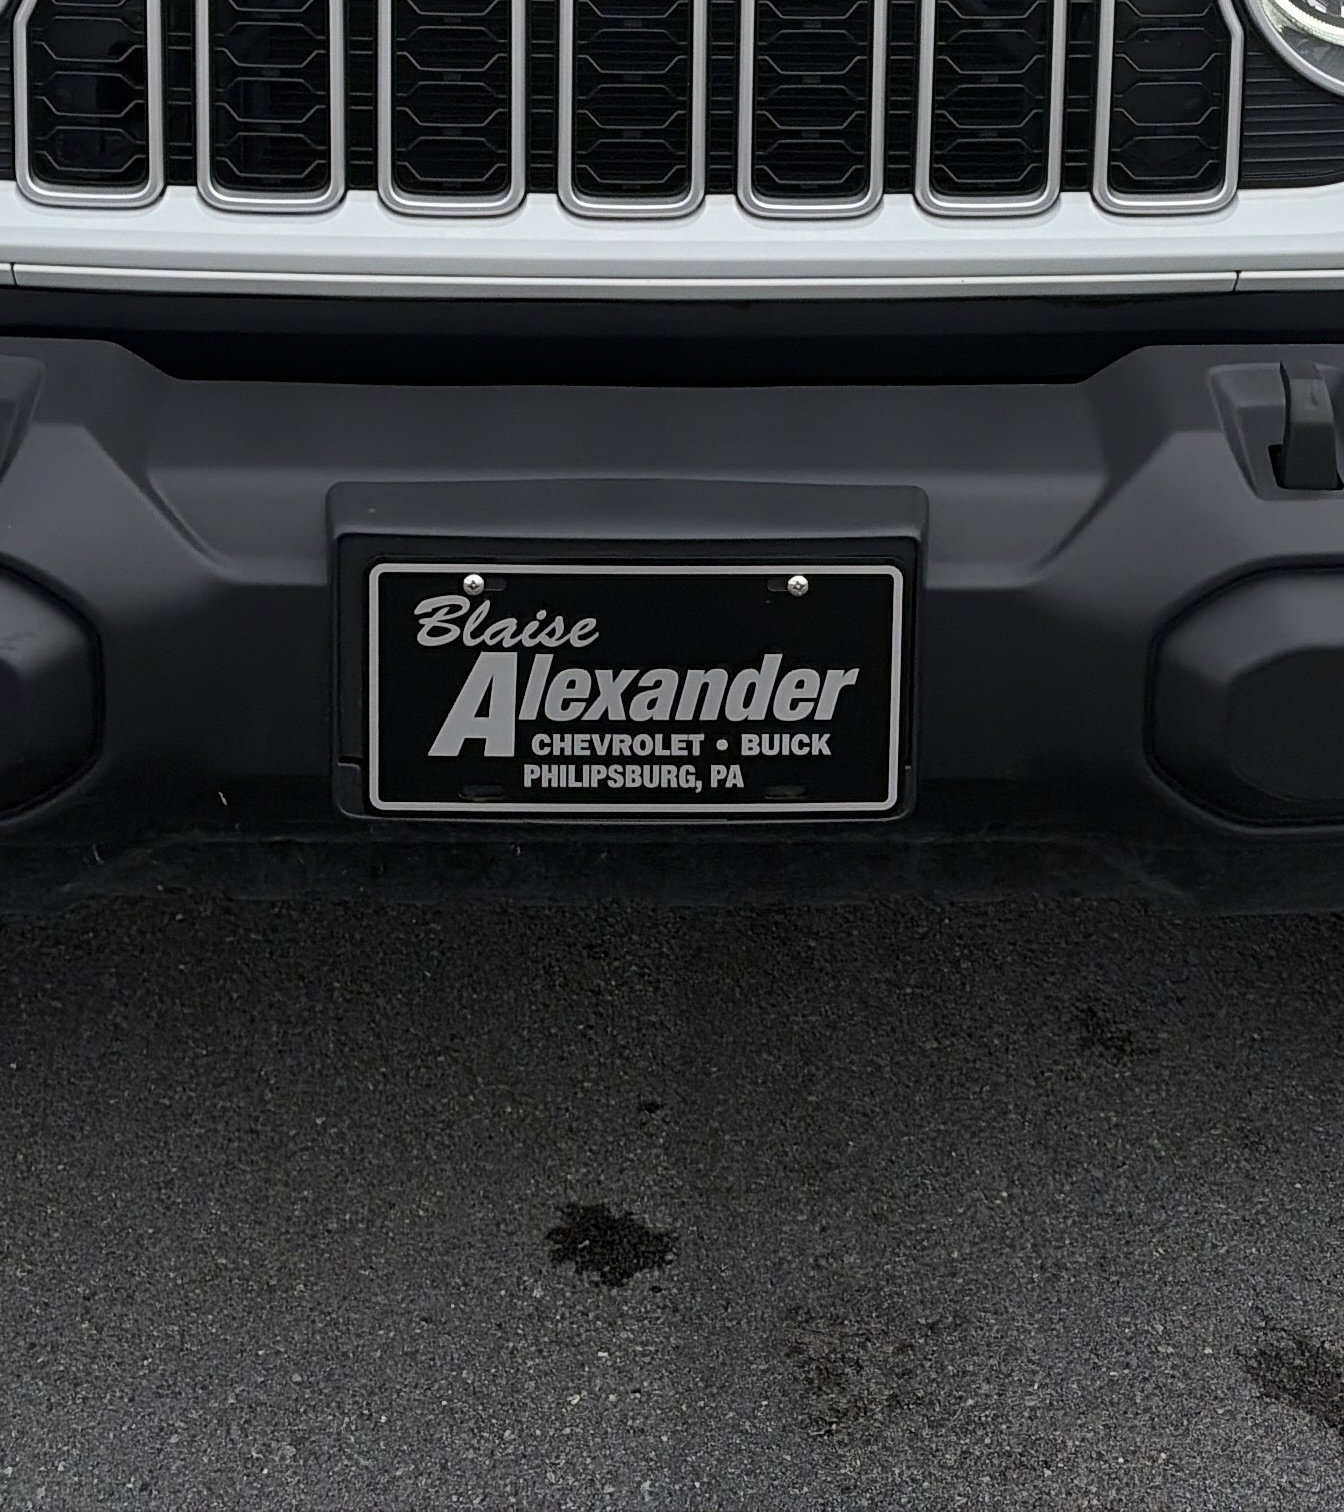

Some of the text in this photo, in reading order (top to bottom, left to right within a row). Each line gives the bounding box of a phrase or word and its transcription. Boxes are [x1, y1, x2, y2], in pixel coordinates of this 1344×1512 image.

[413, 594, 599, 648] Blaise
[428, 651, 860, 757] Alexander
[531, 733, 831, 757] CHEVROLET BUICK
[523, 763, 745, 793] PHILIPSBURG, PA
